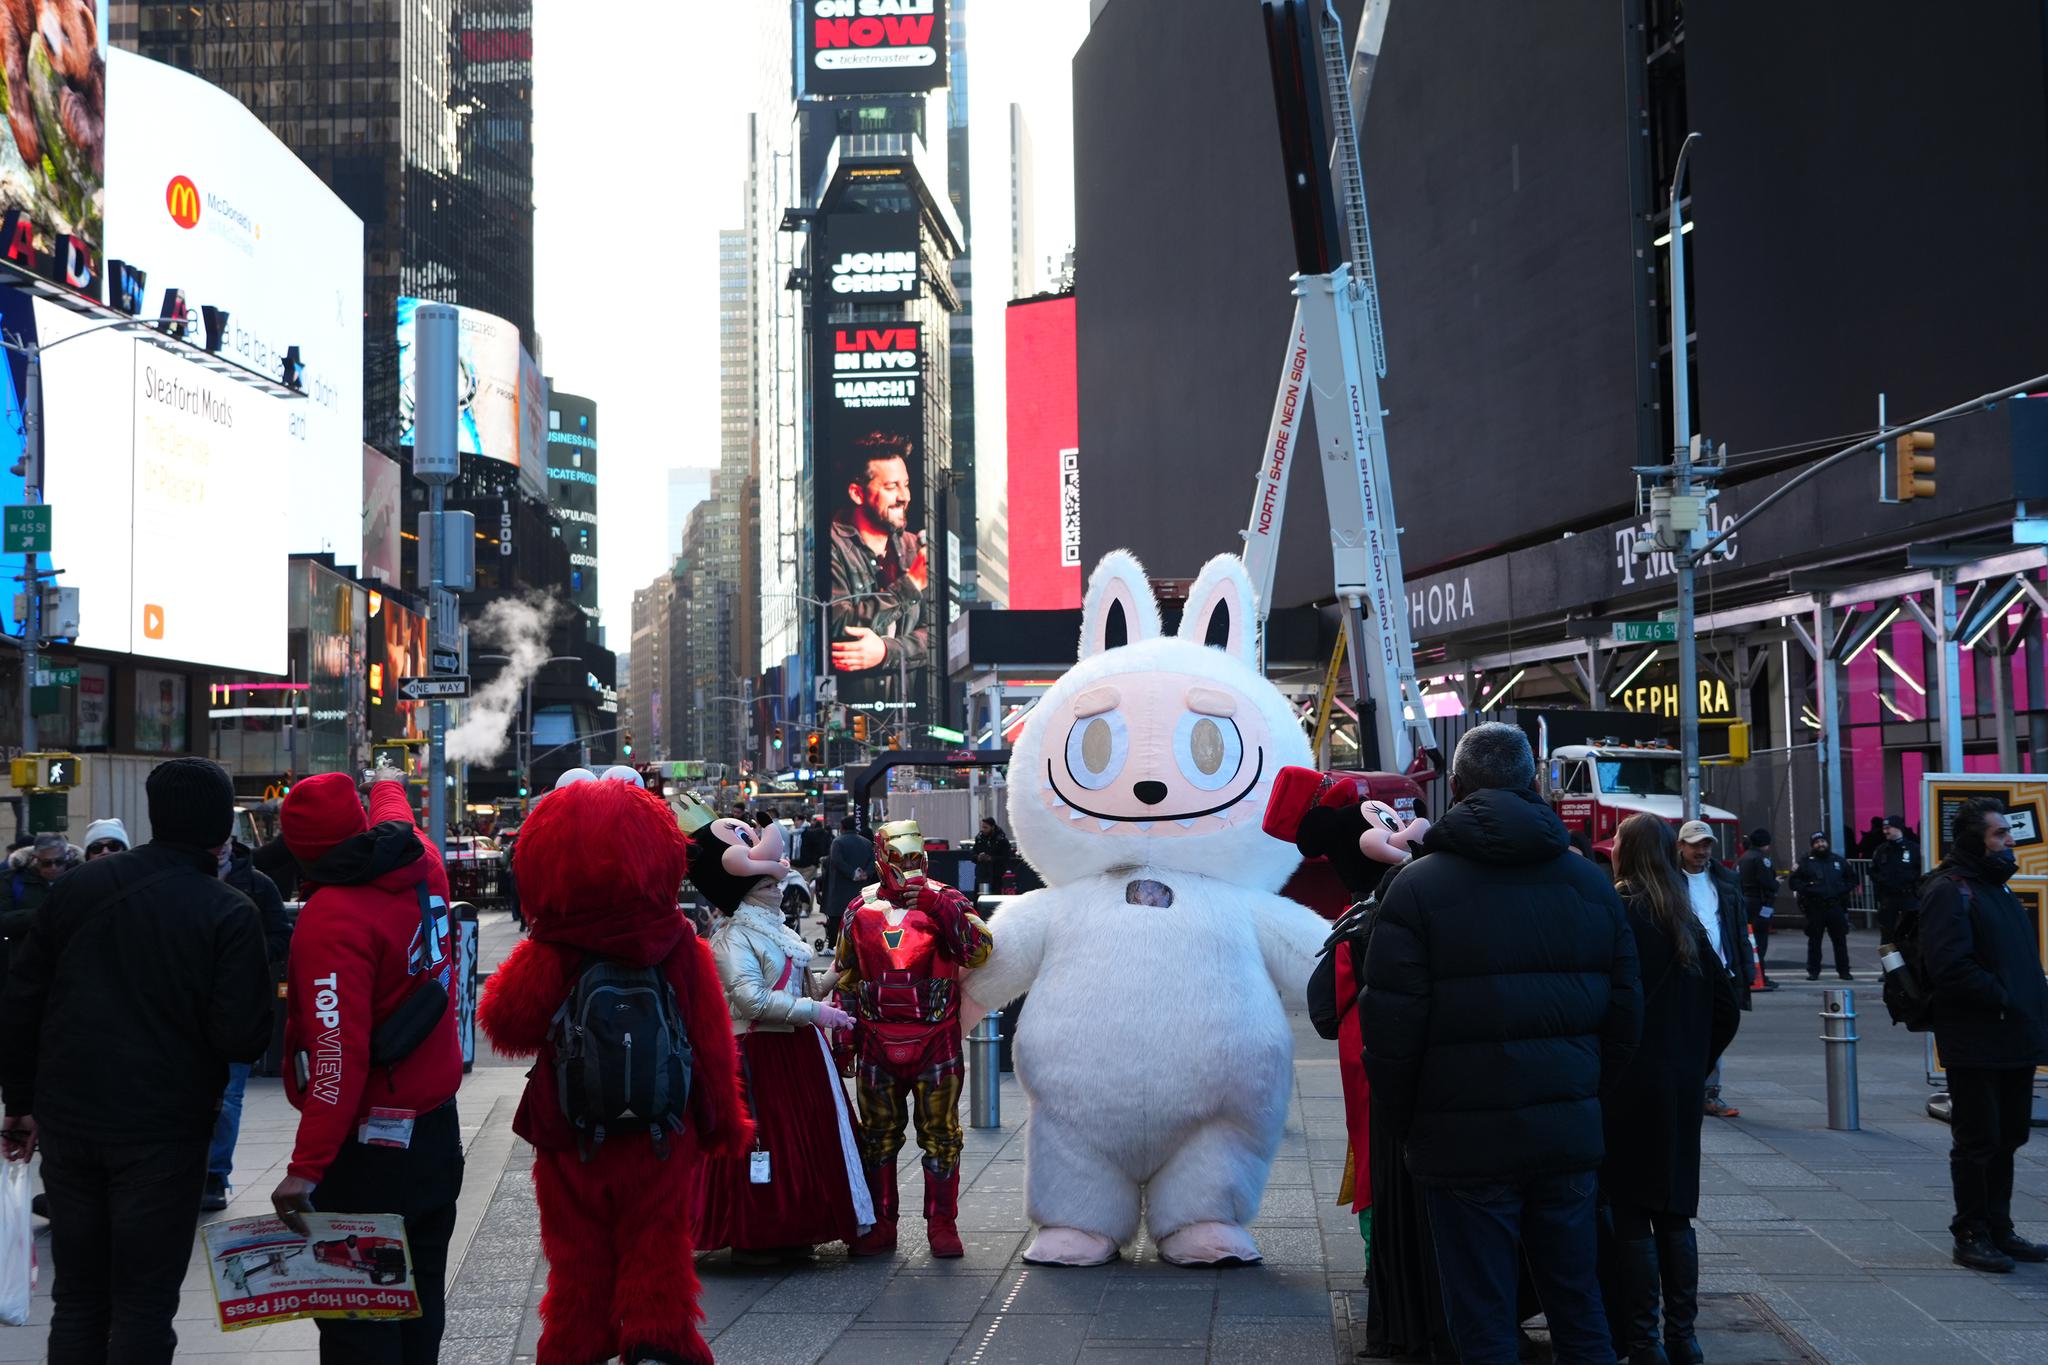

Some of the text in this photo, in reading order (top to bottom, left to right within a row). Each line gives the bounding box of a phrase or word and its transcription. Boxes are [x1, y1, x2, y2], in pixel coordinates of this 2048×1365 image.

[815, 0, 934, 17] ON SALE
[815, 15, 935, 48] NOW
[840, 53, 910, 64] ticketmaster
[832, 252, 916, 274] JOHN
[832, 273, 917, 293] CRIST
[462, 318, 497, 338] SEIKO
[836, 328, 917, 351] LIVE
[834, 351, 917, 369] IN NYC
[1291, 345, 1307, 383] SIGN
[146, 365, 199, 415] Sleaford
[201, 387, 233, 428] Mods
[835, 380, 915, 398] MARCH 1
[844, 398, 910, 407] THE TOWN HALL
[1282, 382, 1301, 428] NEON
[1270, 430, 1290, 481] SHORE
[22, 510, 34, 520] TO
[1258, 484, 1278, 536] NORTH
[10, 523, 46, 534] W 45 St
[500, 500, 512, 556] 1500
[1350, 385, 1393, 665] NORTH SHORE NEON SIGN CO.
[1628, 625, 1640, 639] W
[1645, 625, 1661, 639] 46
[59, 674, 69, 683] 46
[409, 683, 460, 693] ONE WAY
[1623, 680, 1730, 717] SEPHRA
[900, 769, 913, 777] 25
[313, 971, 343, 1105] TOPVIEW
[225, 1292, 410, 1317] Hop-On Hop-Off Pass
